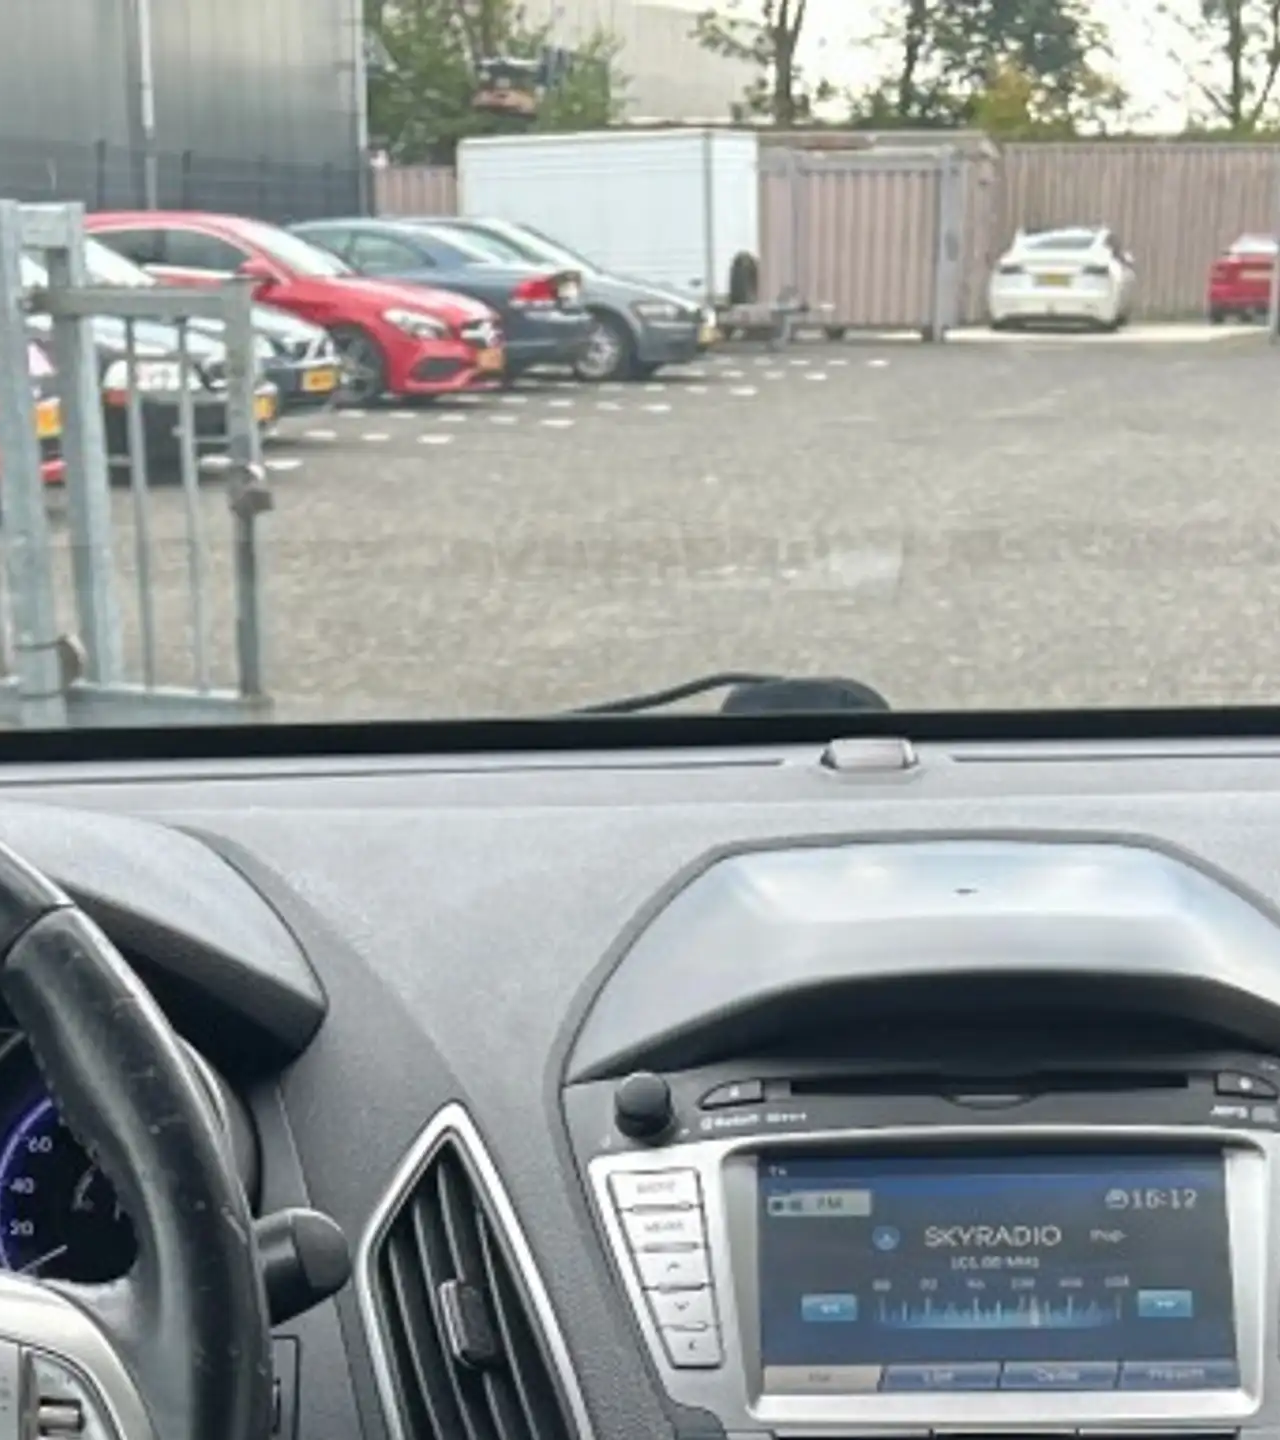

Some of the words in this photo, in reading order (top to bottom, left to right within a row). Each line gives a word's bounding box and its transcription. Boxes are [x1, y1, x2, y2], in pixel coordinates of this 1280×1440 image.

[27, 1135, 53, 1153] 60
[10, 1220, 35, 1236] 20
[923, 1225, 1062, 1248] SKYRADIO
